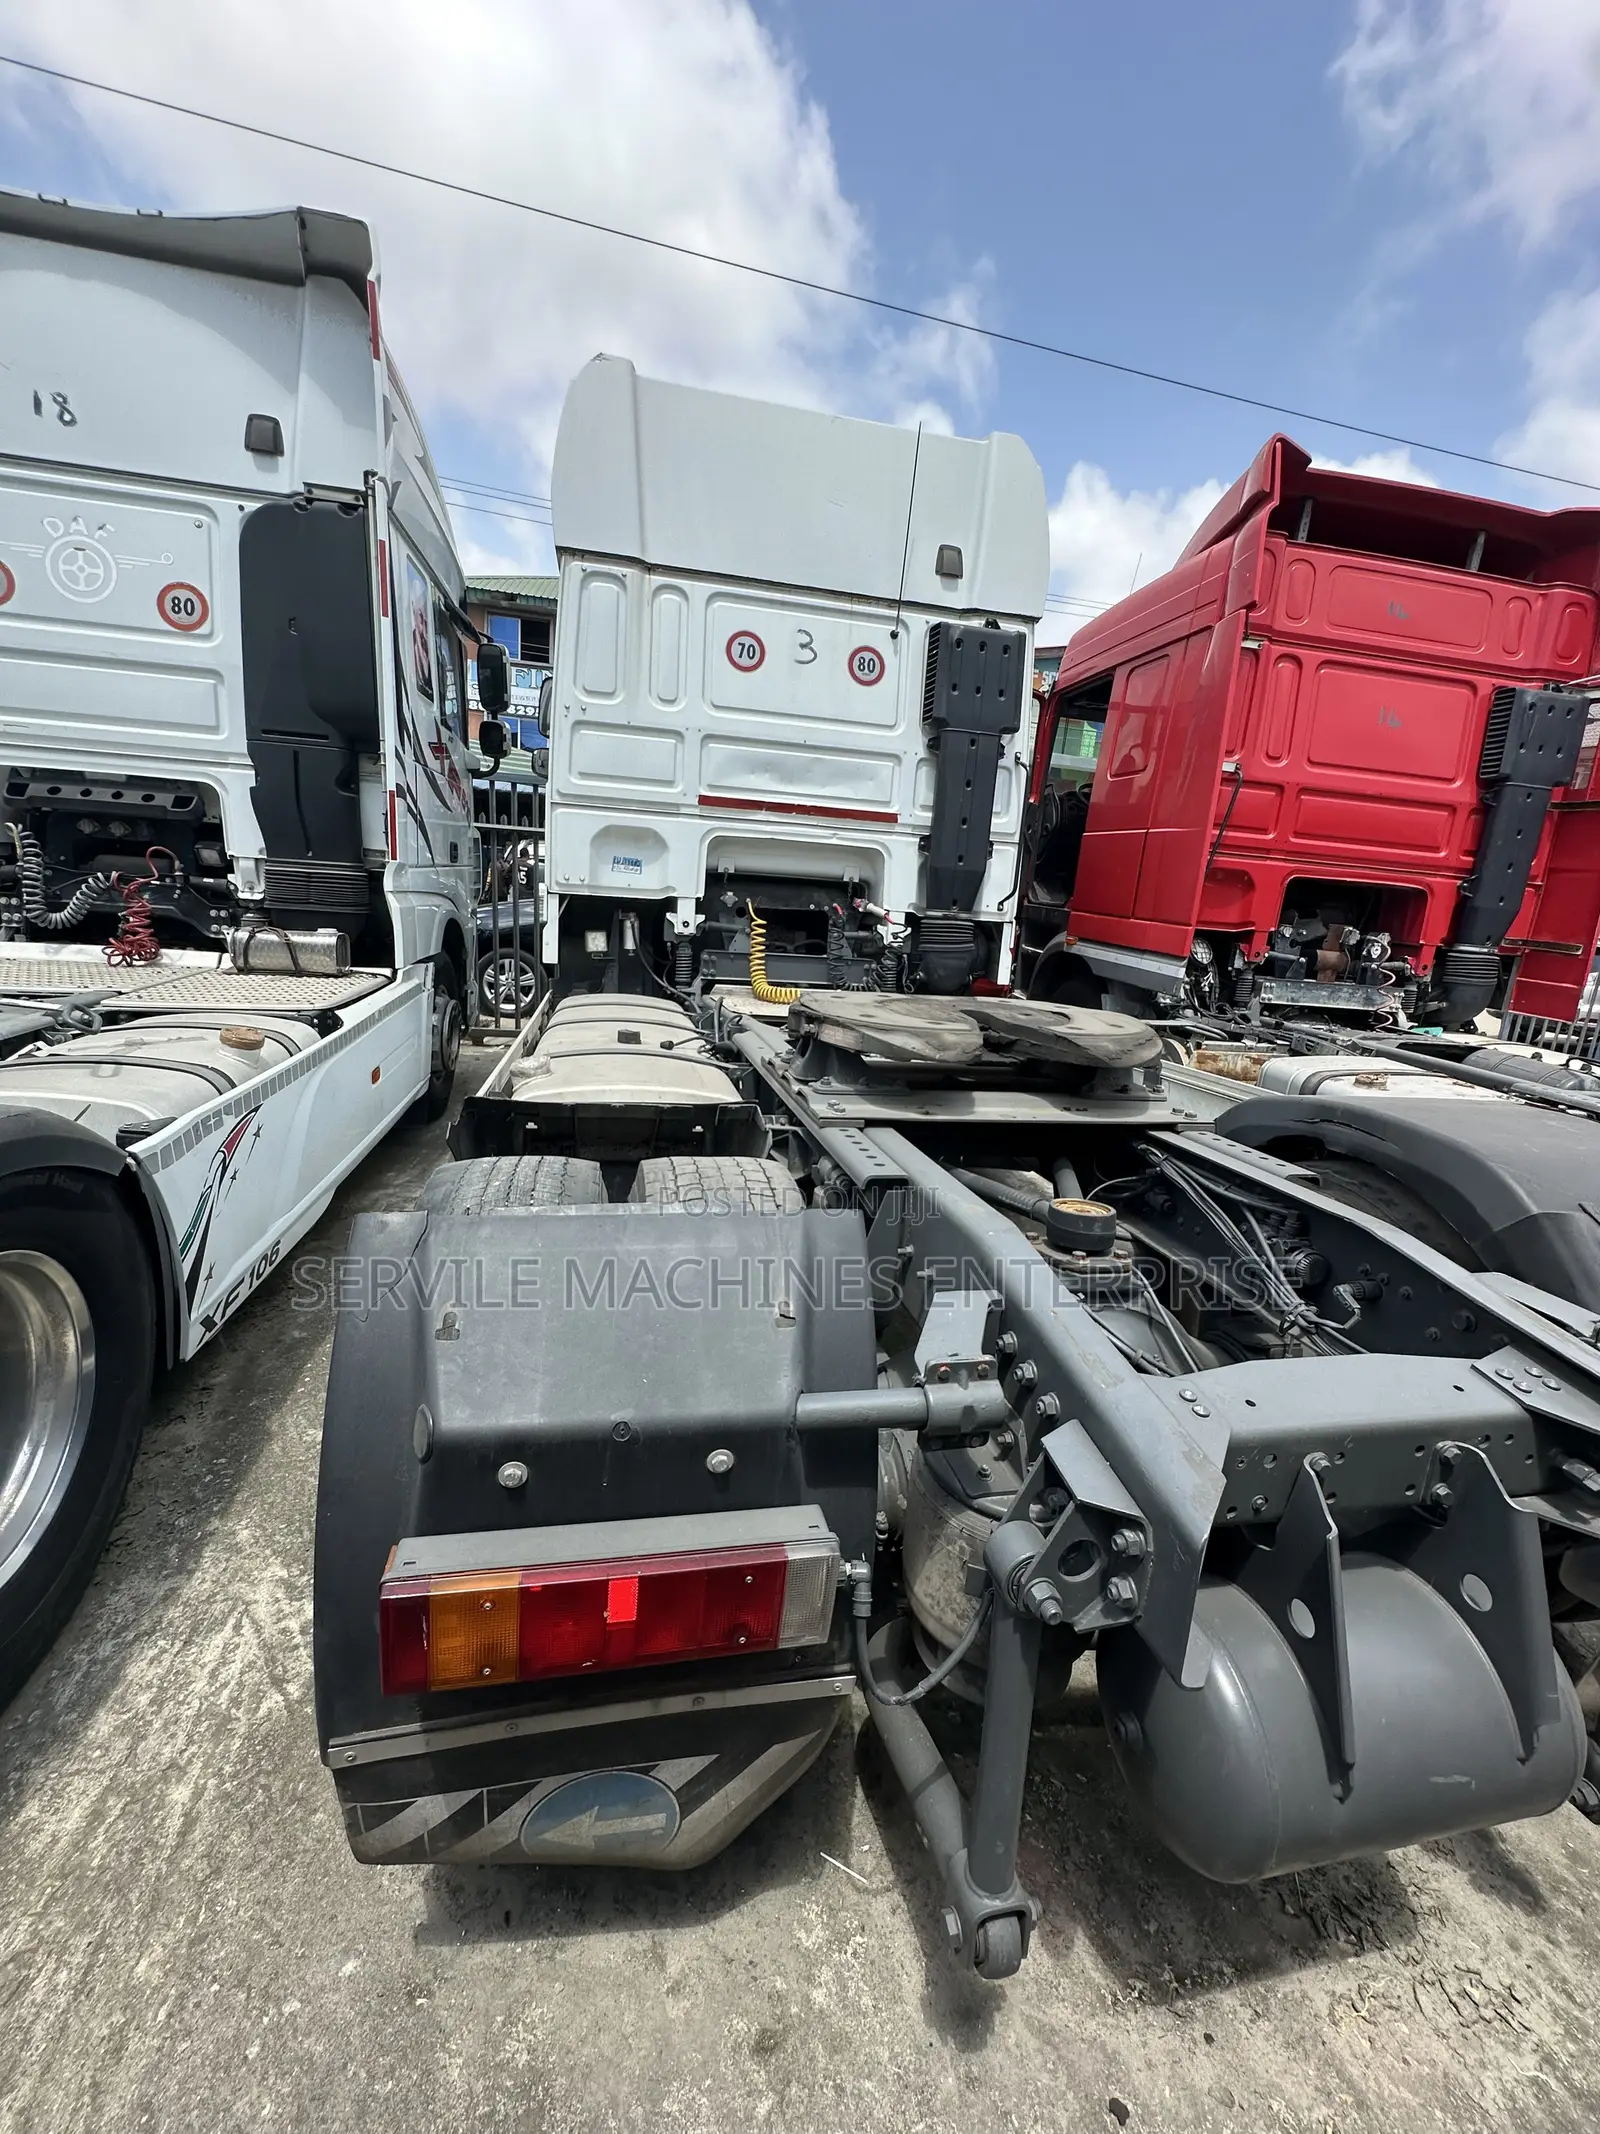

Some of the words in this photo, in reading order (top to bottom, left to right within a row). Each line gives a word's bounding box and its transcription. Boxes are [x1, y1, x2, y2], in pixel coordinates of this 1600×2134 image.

[33, 390, 77, 427] 18
[41, 514, 115, 539] DAF
[171, 596, 195, 617] 80
[738, 642, 756, 660] 70
[794, 628, 818, 664] 3
[857, 656, 876, 673] 80
[248, 1239, 282, 1290] 106
